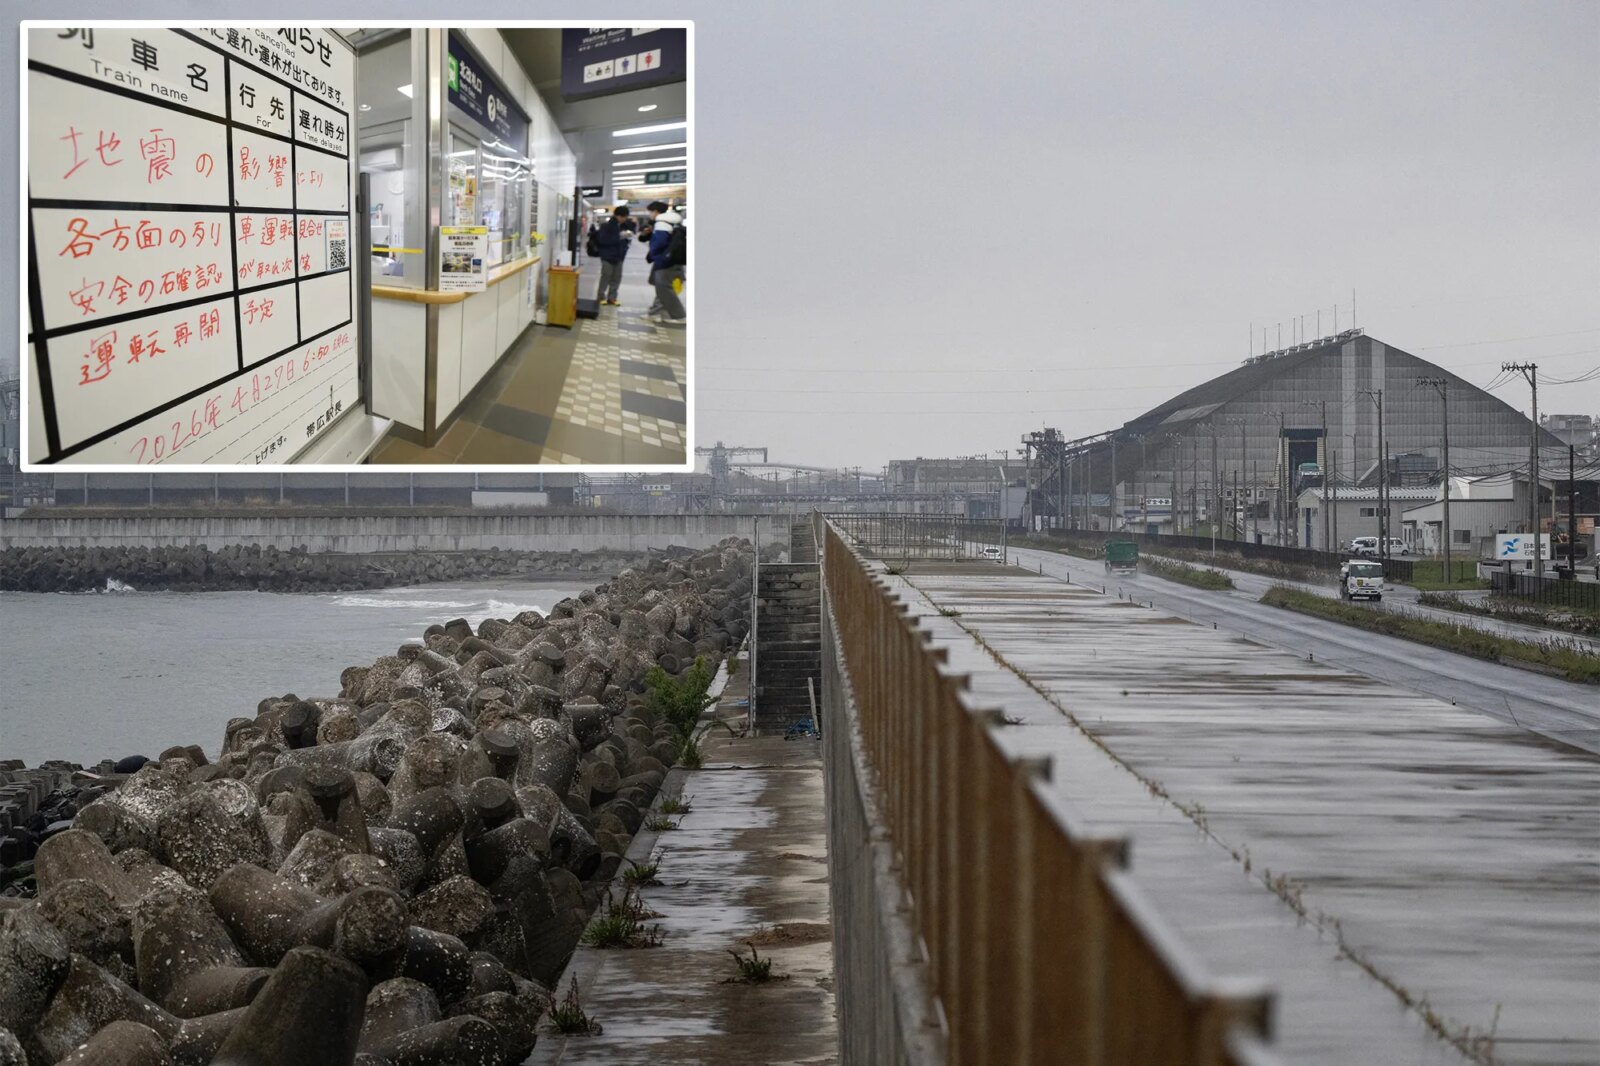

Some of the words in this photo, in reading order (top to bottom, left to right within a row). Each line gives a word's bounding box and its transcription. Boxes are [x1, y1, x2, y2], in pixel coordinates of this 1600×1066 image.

[254, 28, 296, 58] cancelled
[90, 57, 142, 88] Train
[151, 81, 188, 103] name
[239, 82, 285, 121] 行先
[256, 115, 272, 128] For
[298, 109, 345, 142] 遅れ時分
[303, 131, 318, 144] Time
[320, 138, 342, 152] delayed
[303, 345, 329, 372] 6:50
